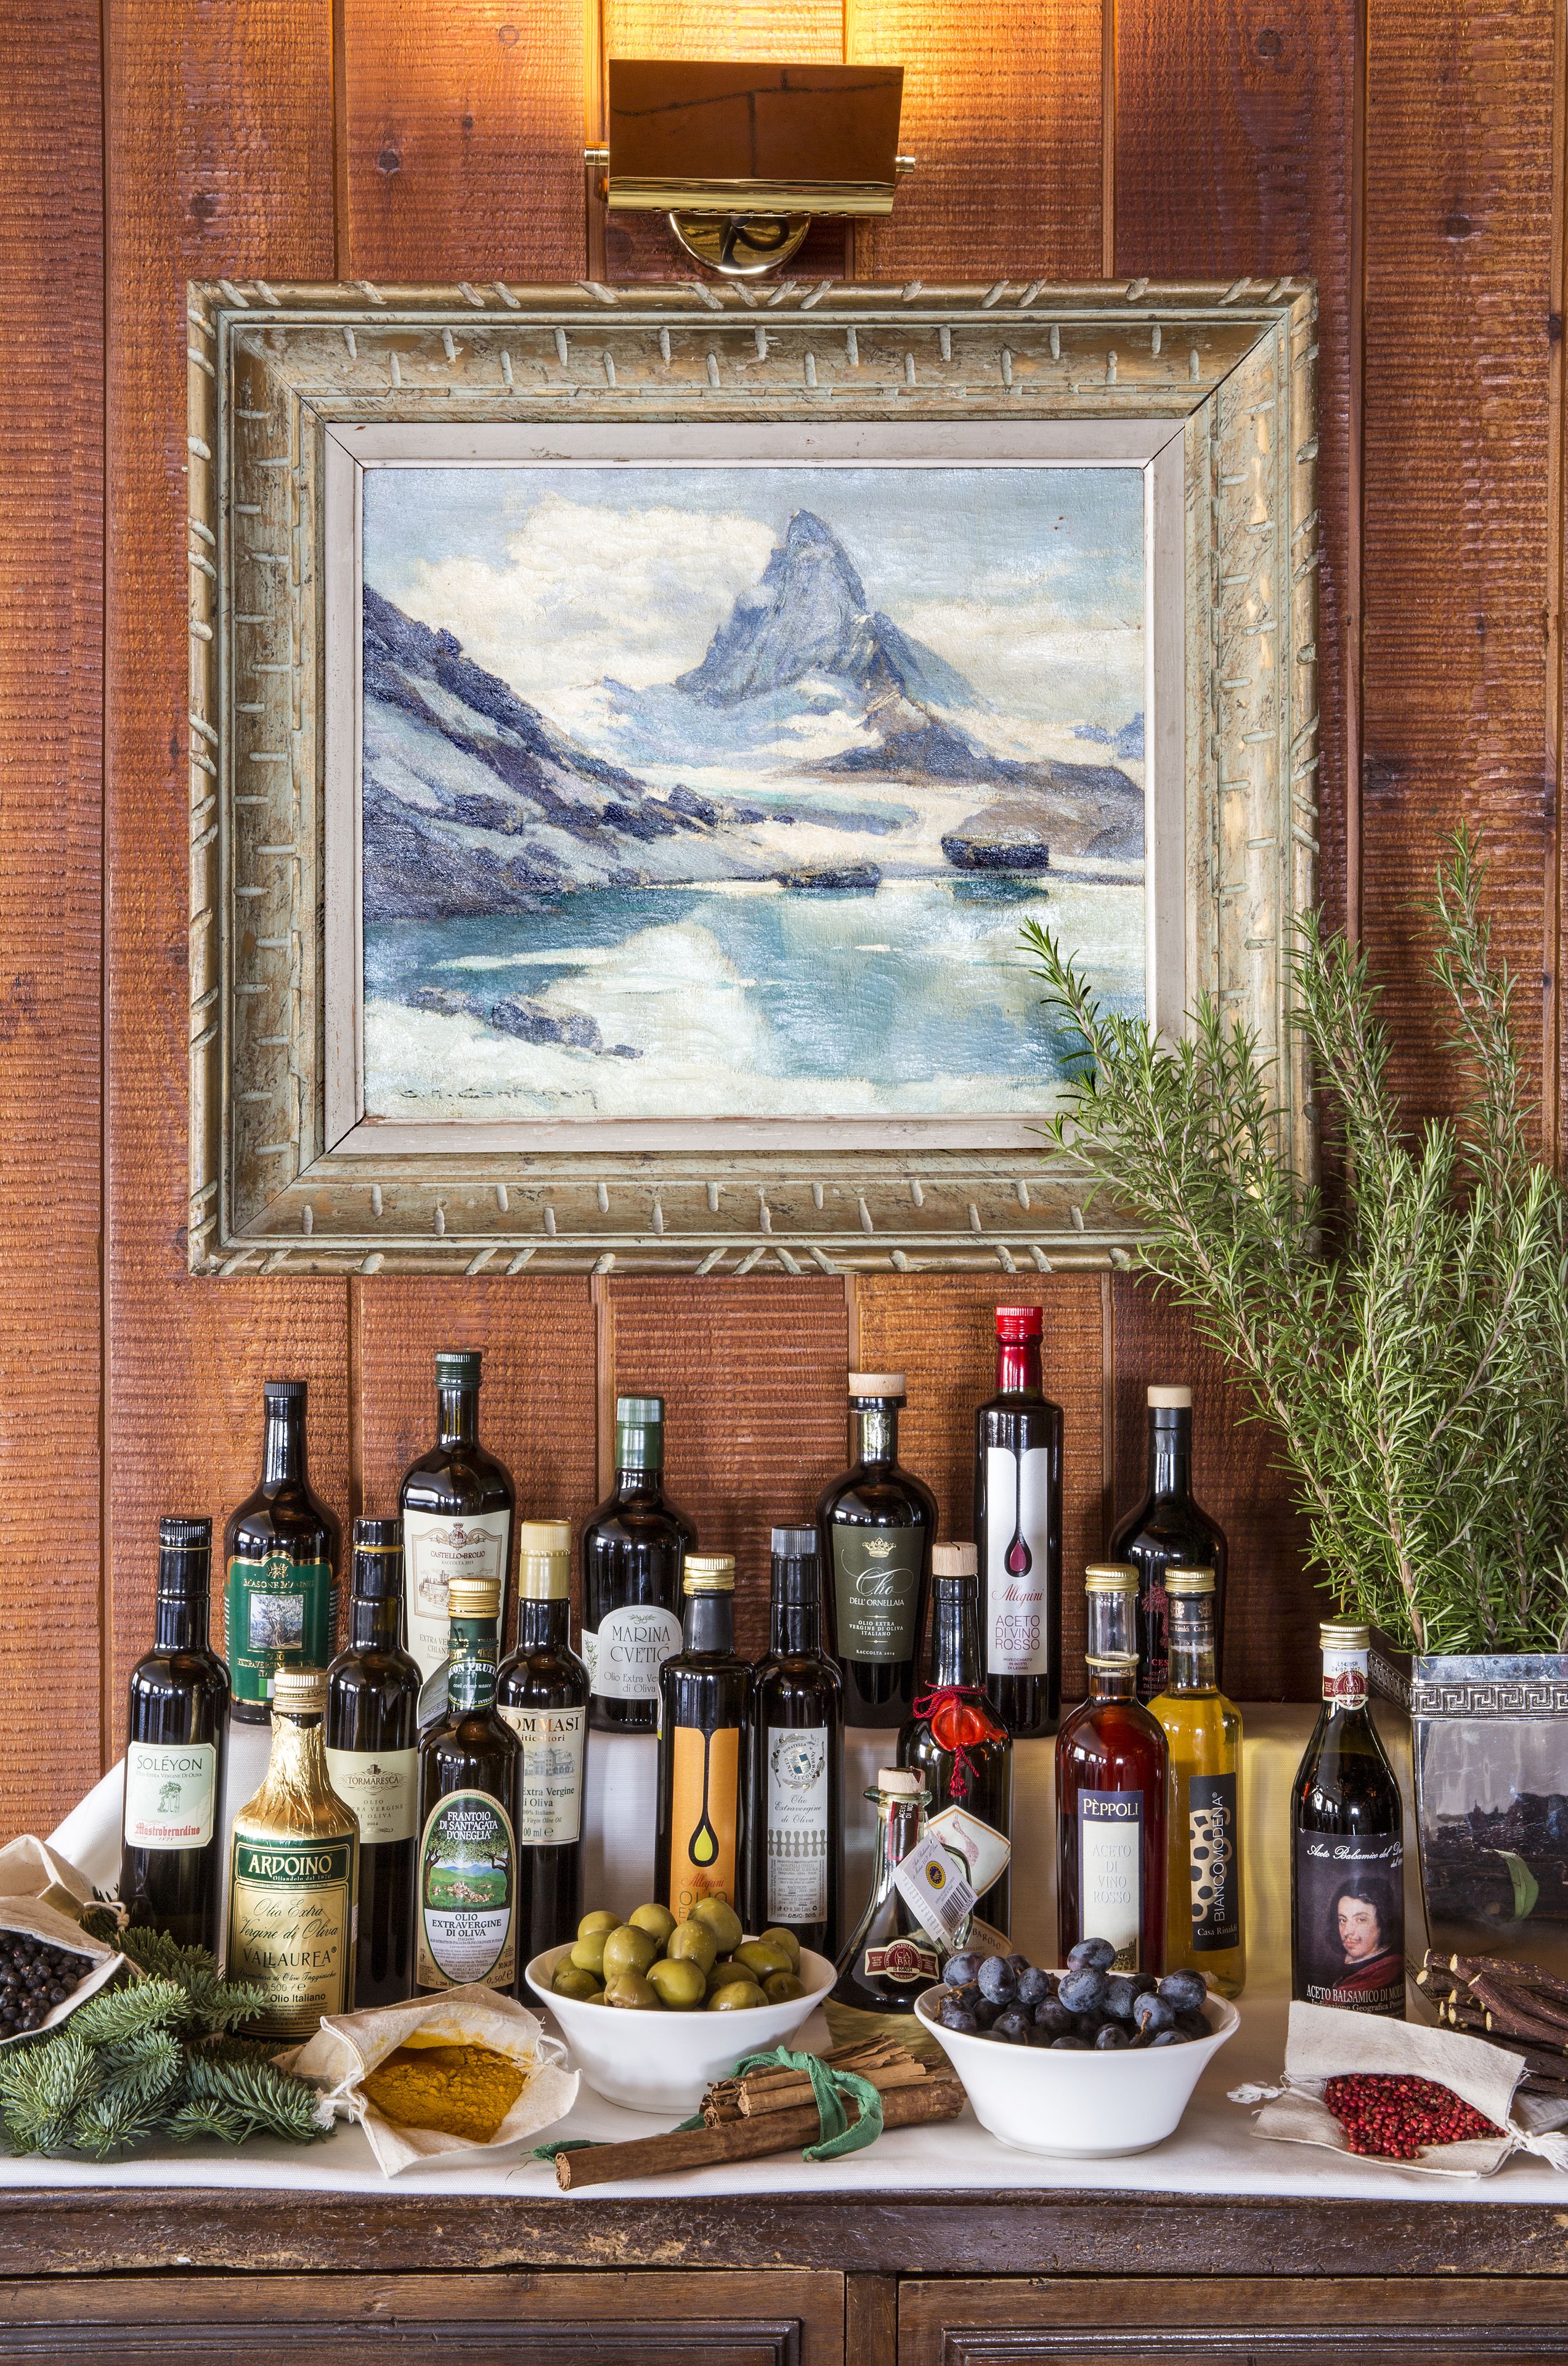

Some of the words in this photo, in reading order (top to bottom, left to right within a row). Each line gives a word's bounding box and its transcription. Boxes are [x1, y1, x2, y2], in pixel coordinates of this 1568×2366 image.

[431, 1551, 461, 1559] CASTELLO
[464, 1551, 485, 1559] BROLIO
[243, 1579, 278, 1588] MASONE
[854, 1567, 904, 1596] Olio
[849, 1597, 866, 1606] DELL'
[992, 1583, 1044, 1609] Allegrini
[996, 1615, 1040, 1627] ACETO
[612, 1625, 670, 1643] MARINA
[996, 1627, 1007, 1638] DI
[1010, 1628, 1040, 1638] VINO
[420, 1634, 437, 1644] EXTRA
[996, 1639, 1040, 1650] ROSSO
[604, 1672, 620, 1681] Olio
[623, 1674, 643, 1682] Extra
[633, 1685, 656, 1693] Oliva
[521, 1734, 566, 1742] iticoltori
[783, 1742, 806, 1754] DONATELLA
[137, 1755, 202, 1771] SOLÉYON
[784, 1757, 800, 1781] CINELLI
[801, 1751, 816, 1781] COLOMBINI
[348, 1775, 400, 1785] TORMARESCA
[522, 1787, 543, 1797] Extra
[546, 1787, 575, 1798] Vergine
[530, 1798, 553, 1807] Oliva
[791, 1794, 807, 1804] Olio
[775, 1801, 822, 1815] Extravergine
[1083, 1798, 1139, 1816] PÈPPOLI
[447, 1811, 490, 1821] FRANTOIO
[793, 1814, 814, 1824] Oliva
[136, 1823, 201, 1836] Mastroberardino
[440, 1820, 447, 1830] DI
[449, 1821, 498, 1831] SANT'AGATA
[447, 1831, 491, 1840] D'ONEGLIA
[533, 1827, 542, 1837] ml
[1093, 1845, 1131, 1857] ACETO
[1307, 1844, 1330, 1858] Aceto
[1333, 1845, 1378, 1860] Balsamico
[1379, 1845, 1392, 1858] del
[1213, 1795, 1225, 1921] BIANCOMODENA
[248, 1855, 331, 1878] ARDOINO
[1107, 1861, 1118, 1873] DI
[681, 1873, 725, 1893] Allegrini
[1099, 1876, 1127, 1888] VINO
[1094, 1892, 1131, 1904] ROSSO
[253, 1898, 282, 1917] Olio
[287, 1899, 323, 1917] Extra
[432, 1919, 502, 1929] EXTRAVERGINE
[239, 1917, 278, 1946] Vergine
[283, 1924, 299, 1940] di
[302, 1919, 339, 1940] Oliva
[446, 1929, 456, 1937] DI
[458, 1929, 487, 1937] OLIVA
[1198, 1928, 1214, 1936] Casa
[1217, 1925, 1237, 1935] Rinaldi
[972, 1928, 1001, 1950] BAROLO
[243, 1948, 331, 1969] VALLAUREA
[885, 1946, 896, 1966] CONSORZIO
[282, 1972, 300, 1982] Olive
[302, 1970, 336, 1983] Taggiasche
[270, 1994, 290, 2002] Olio
[292, 1993, 327, 2002] Italiano
[1307, 1984, 1331, 2001] ACETO
[1333, 1989, 1379, 2002] BALSAMICO
[1380, 1988, 1387, 2002] DI
[1352, 2002, 1389, 2014] Geografica
